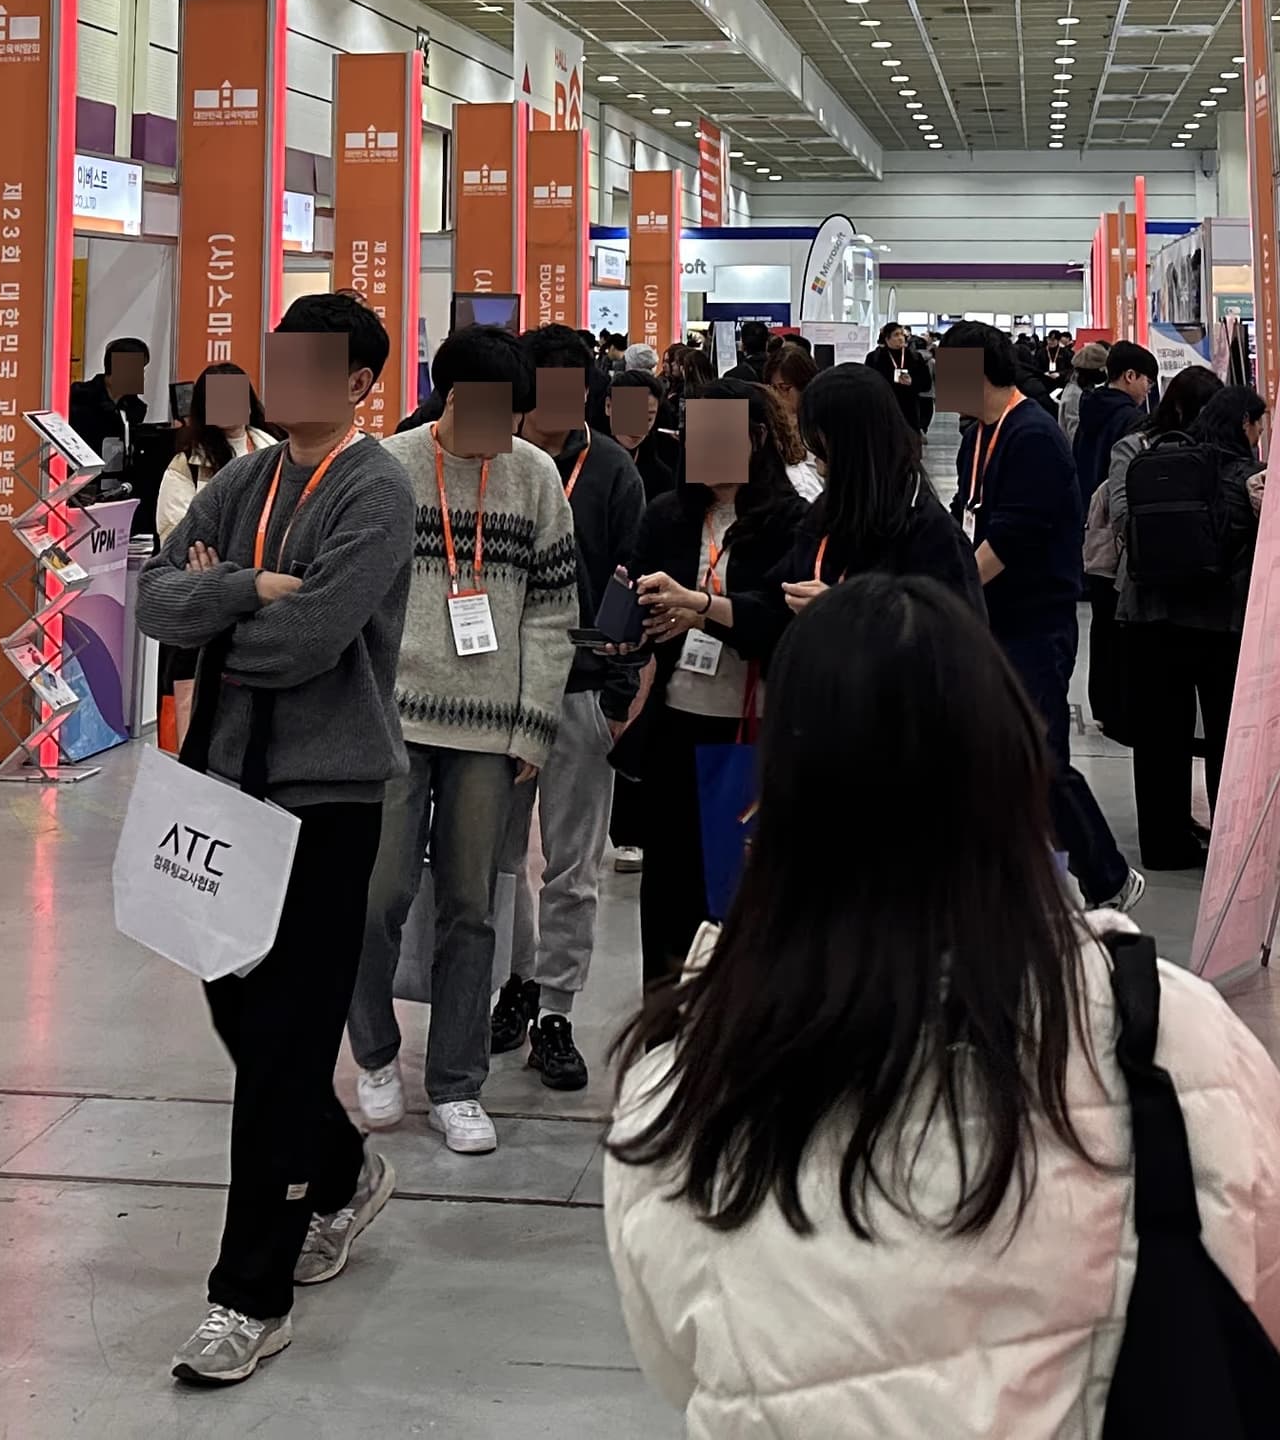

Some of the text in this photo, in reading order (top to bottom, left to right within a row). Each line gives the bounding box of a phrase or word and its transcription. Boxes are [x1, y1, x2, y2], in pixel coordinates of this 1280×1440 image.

[0, 182, 23, 264] 제23회
[819, 231, 846, 278] Microsoft
[206, 233, 236, 362] (사)스마트
[91, 528, 115, 554] VPM
[153, 854, 220, 896] 컴퓨팅교사협회
